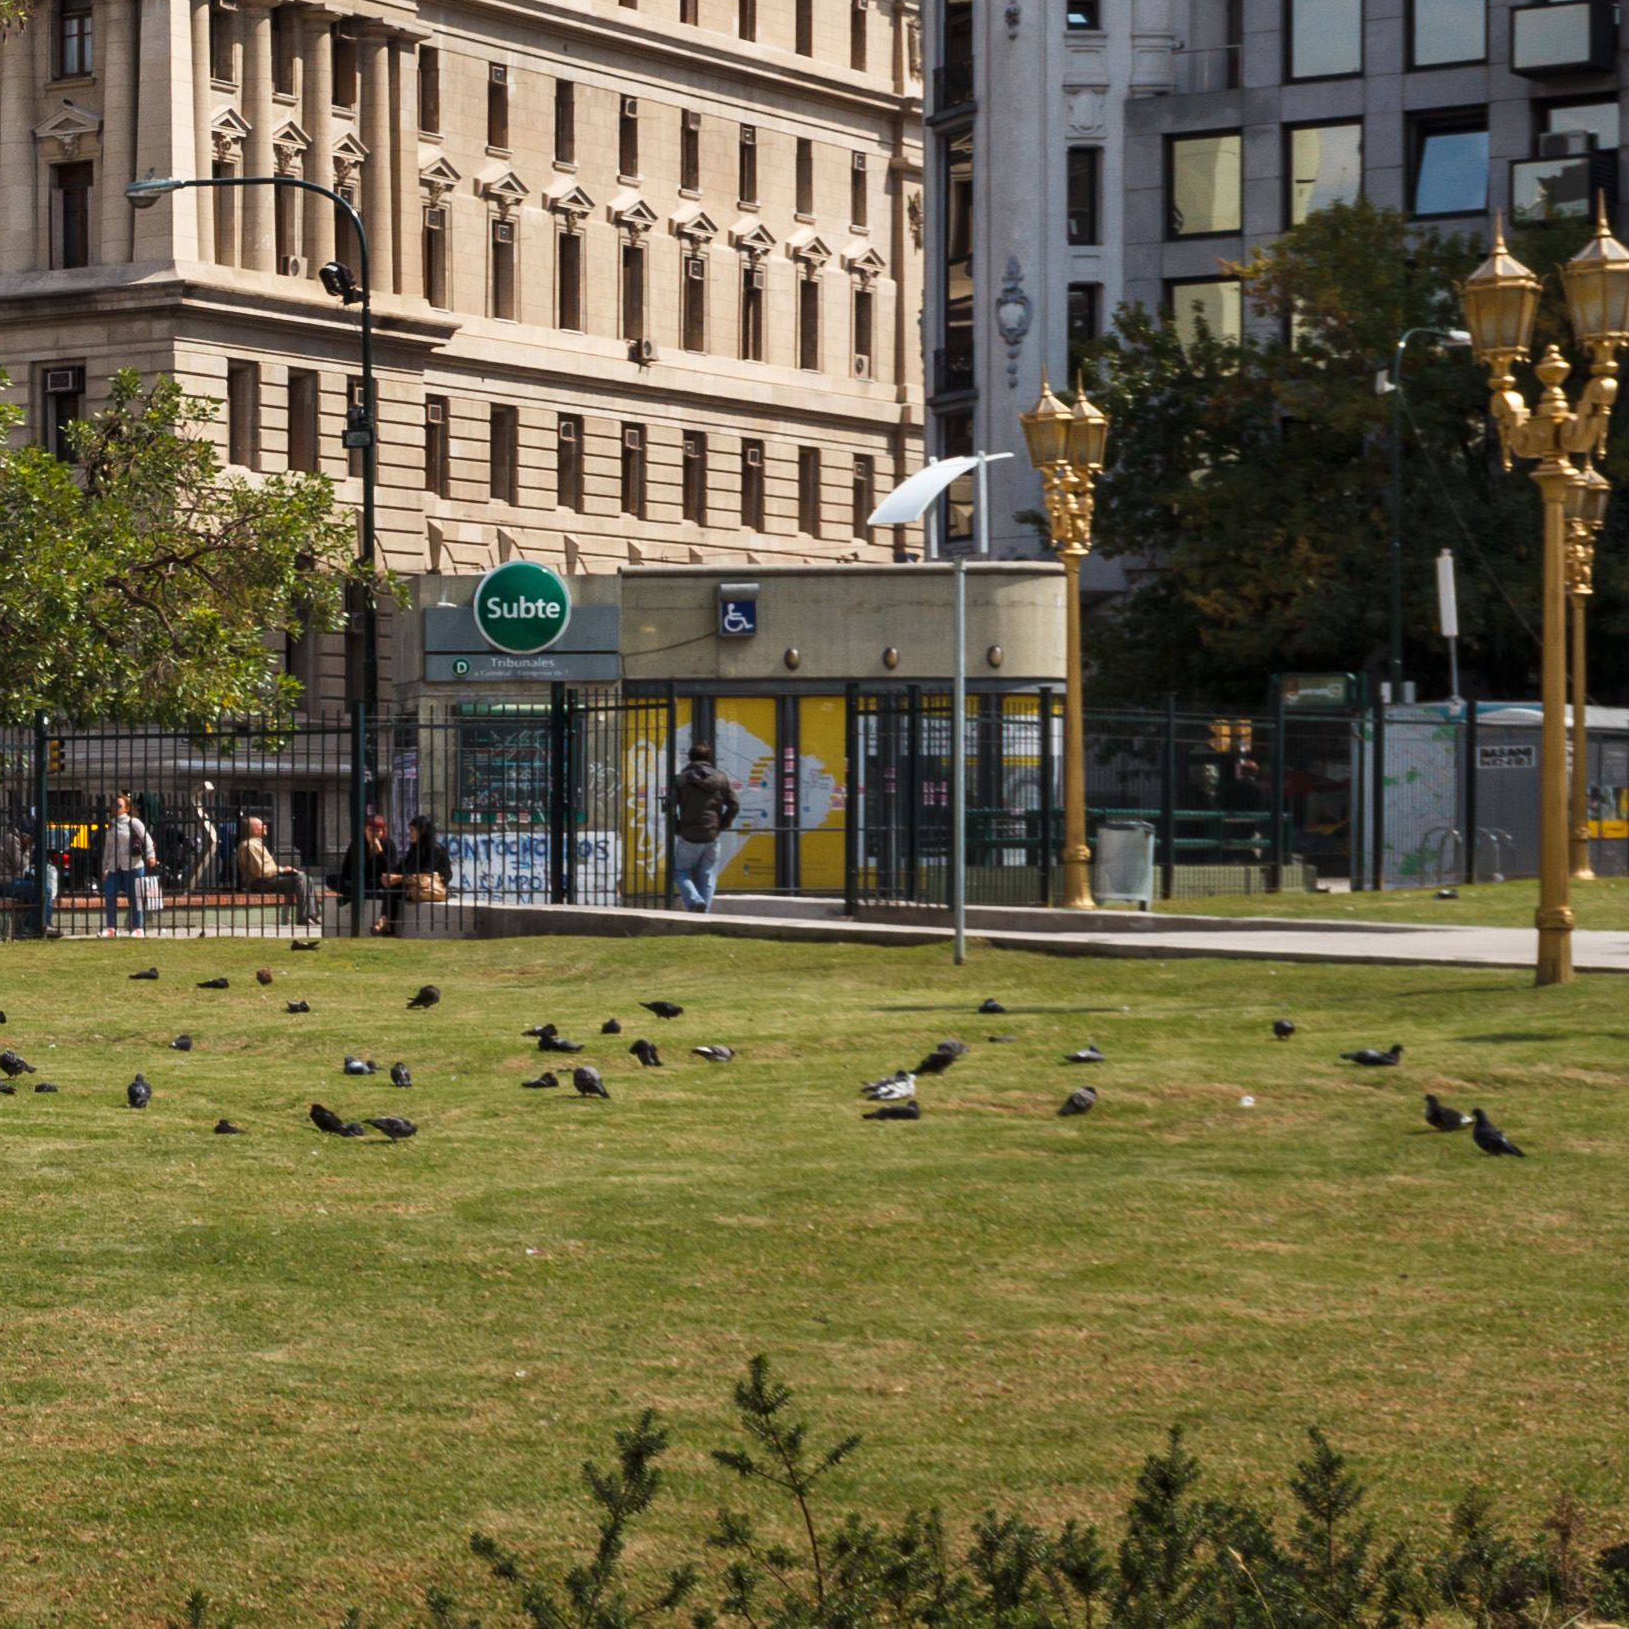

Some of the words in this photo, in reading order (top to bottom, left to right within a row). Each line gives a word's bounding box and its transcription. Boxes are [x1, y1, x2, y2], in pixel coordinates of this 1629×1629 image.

[487, 595, 561, 619] Subte
[457, 661, 467, 674] D
[490, 657, 555, 669] Tribunales
